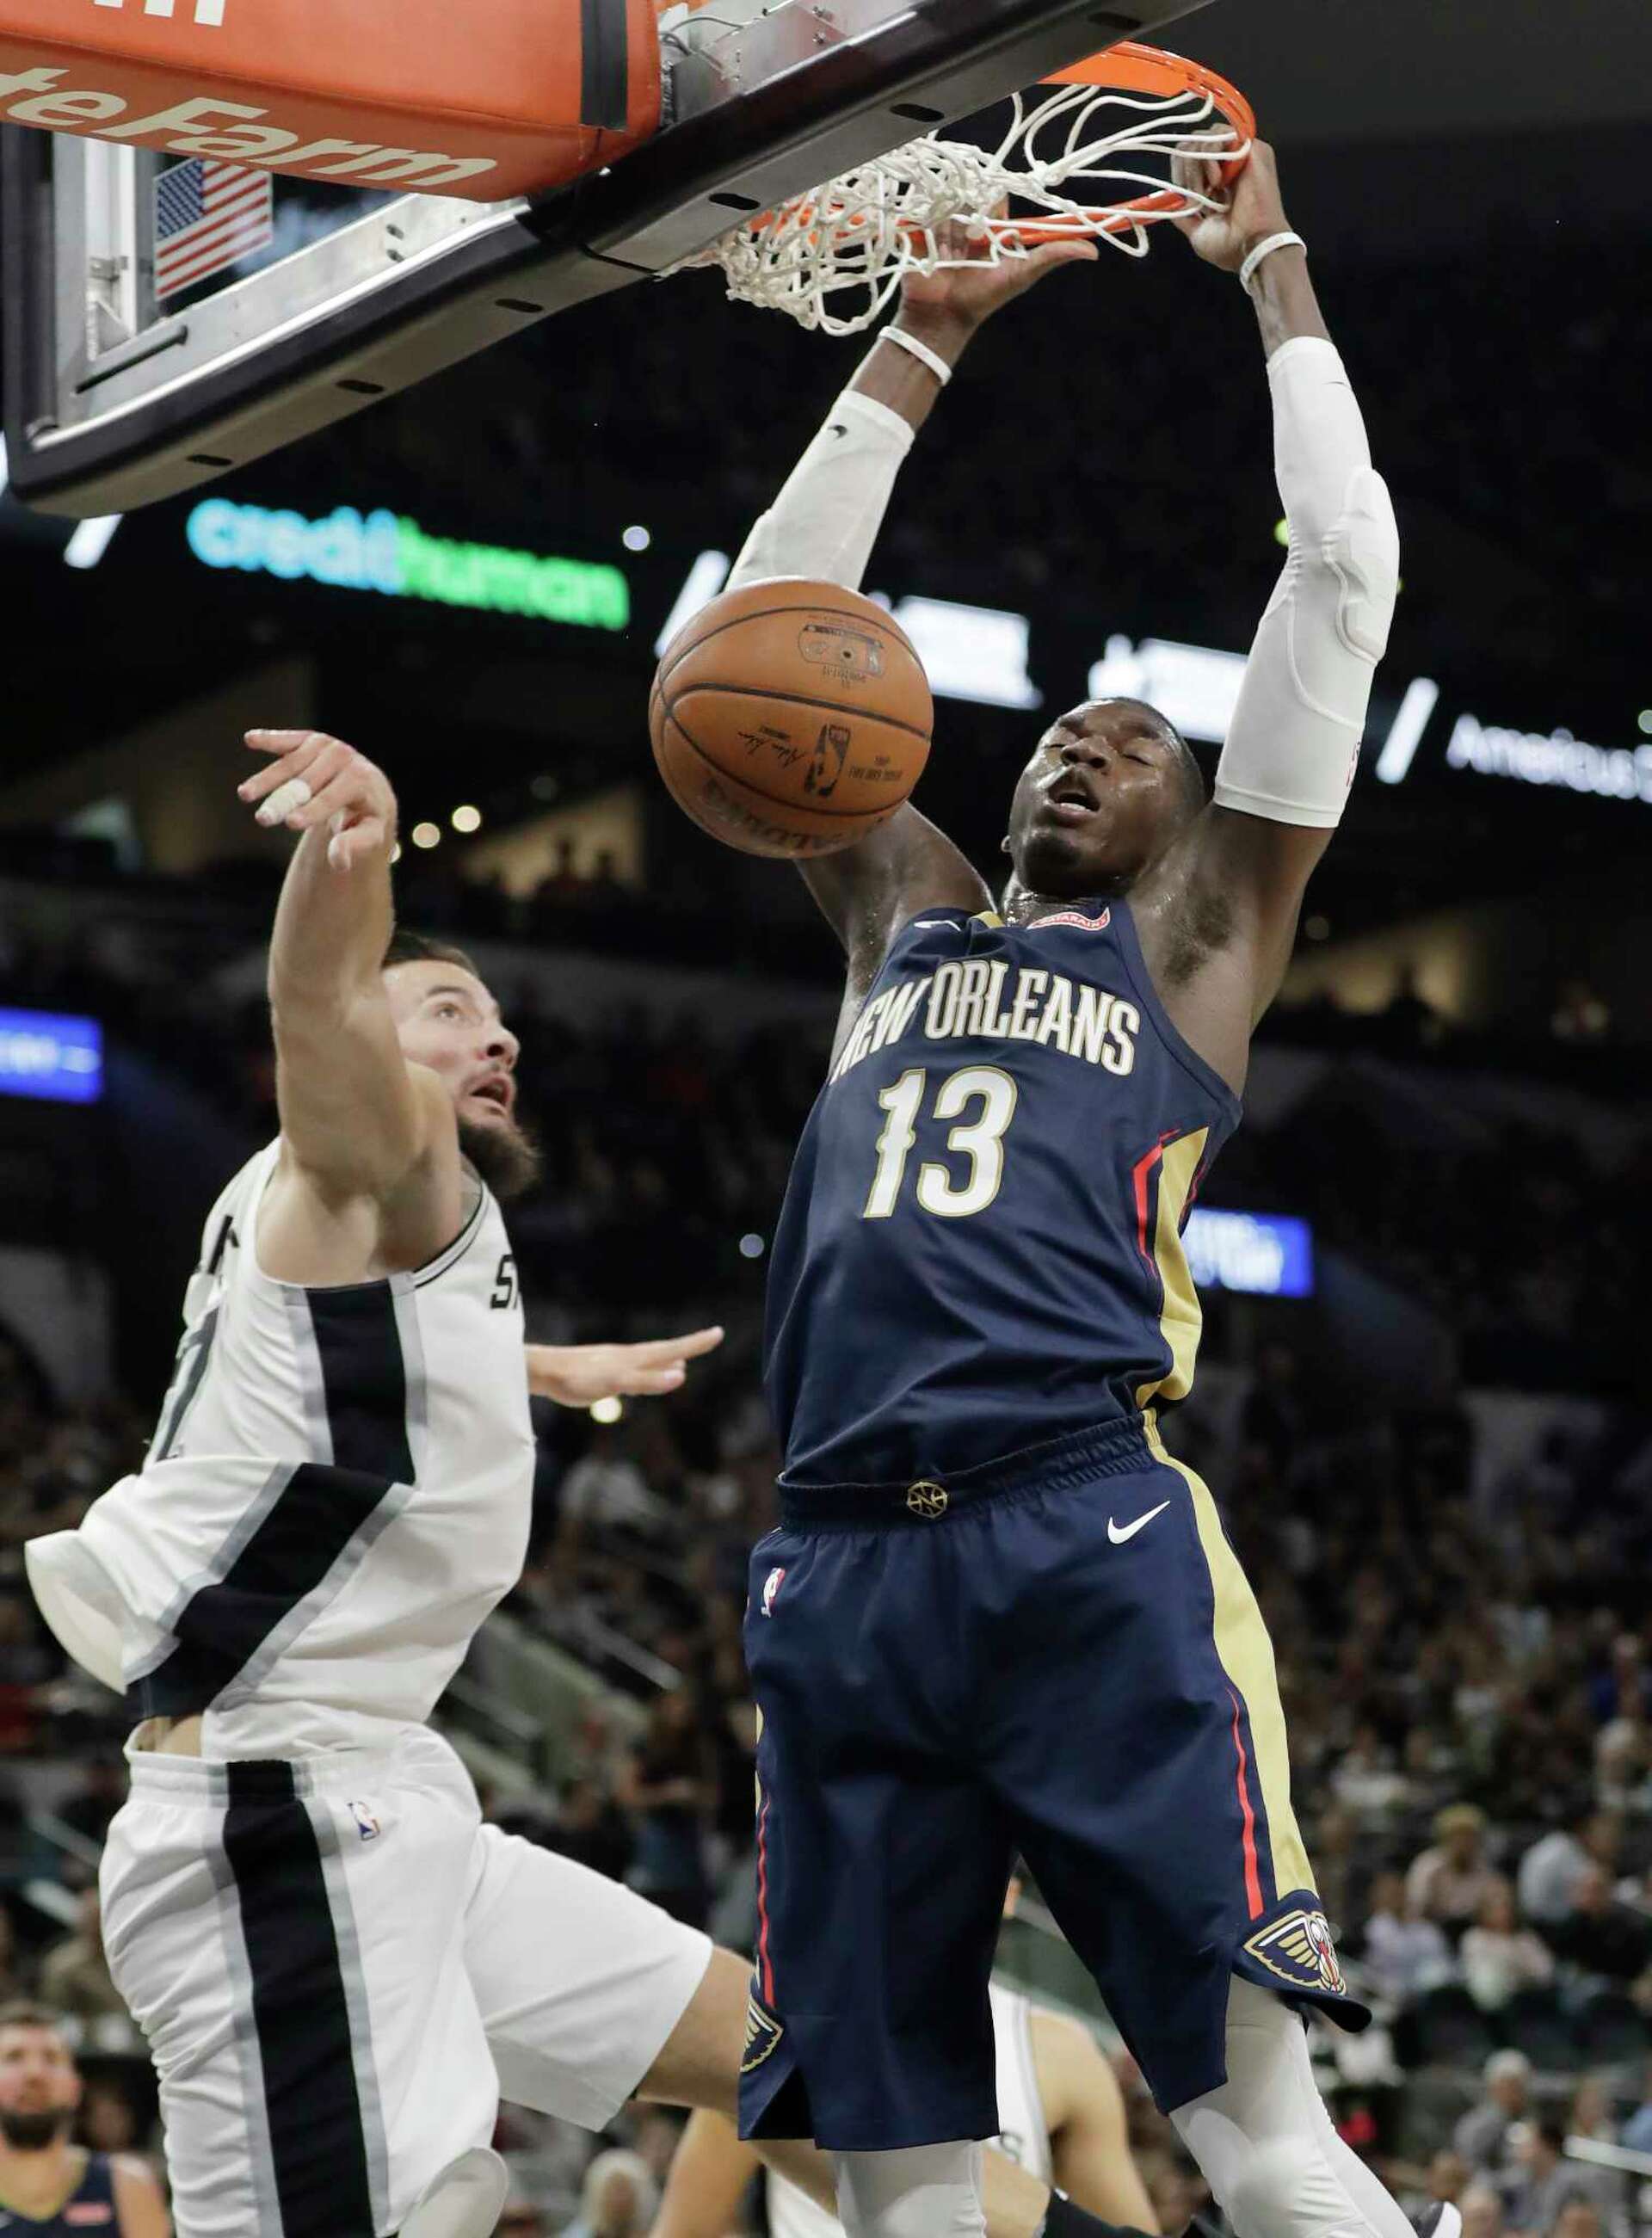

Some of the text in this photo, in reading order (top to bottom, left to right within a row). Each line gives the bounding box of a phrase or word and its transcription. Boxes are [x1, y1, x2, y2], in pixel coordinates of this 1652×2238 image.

[89, 97, 498, 187] Farm
[829, 958, 1141, 1088] NEW ORLEANS
[863, 1065, 1019, 1218] 13
